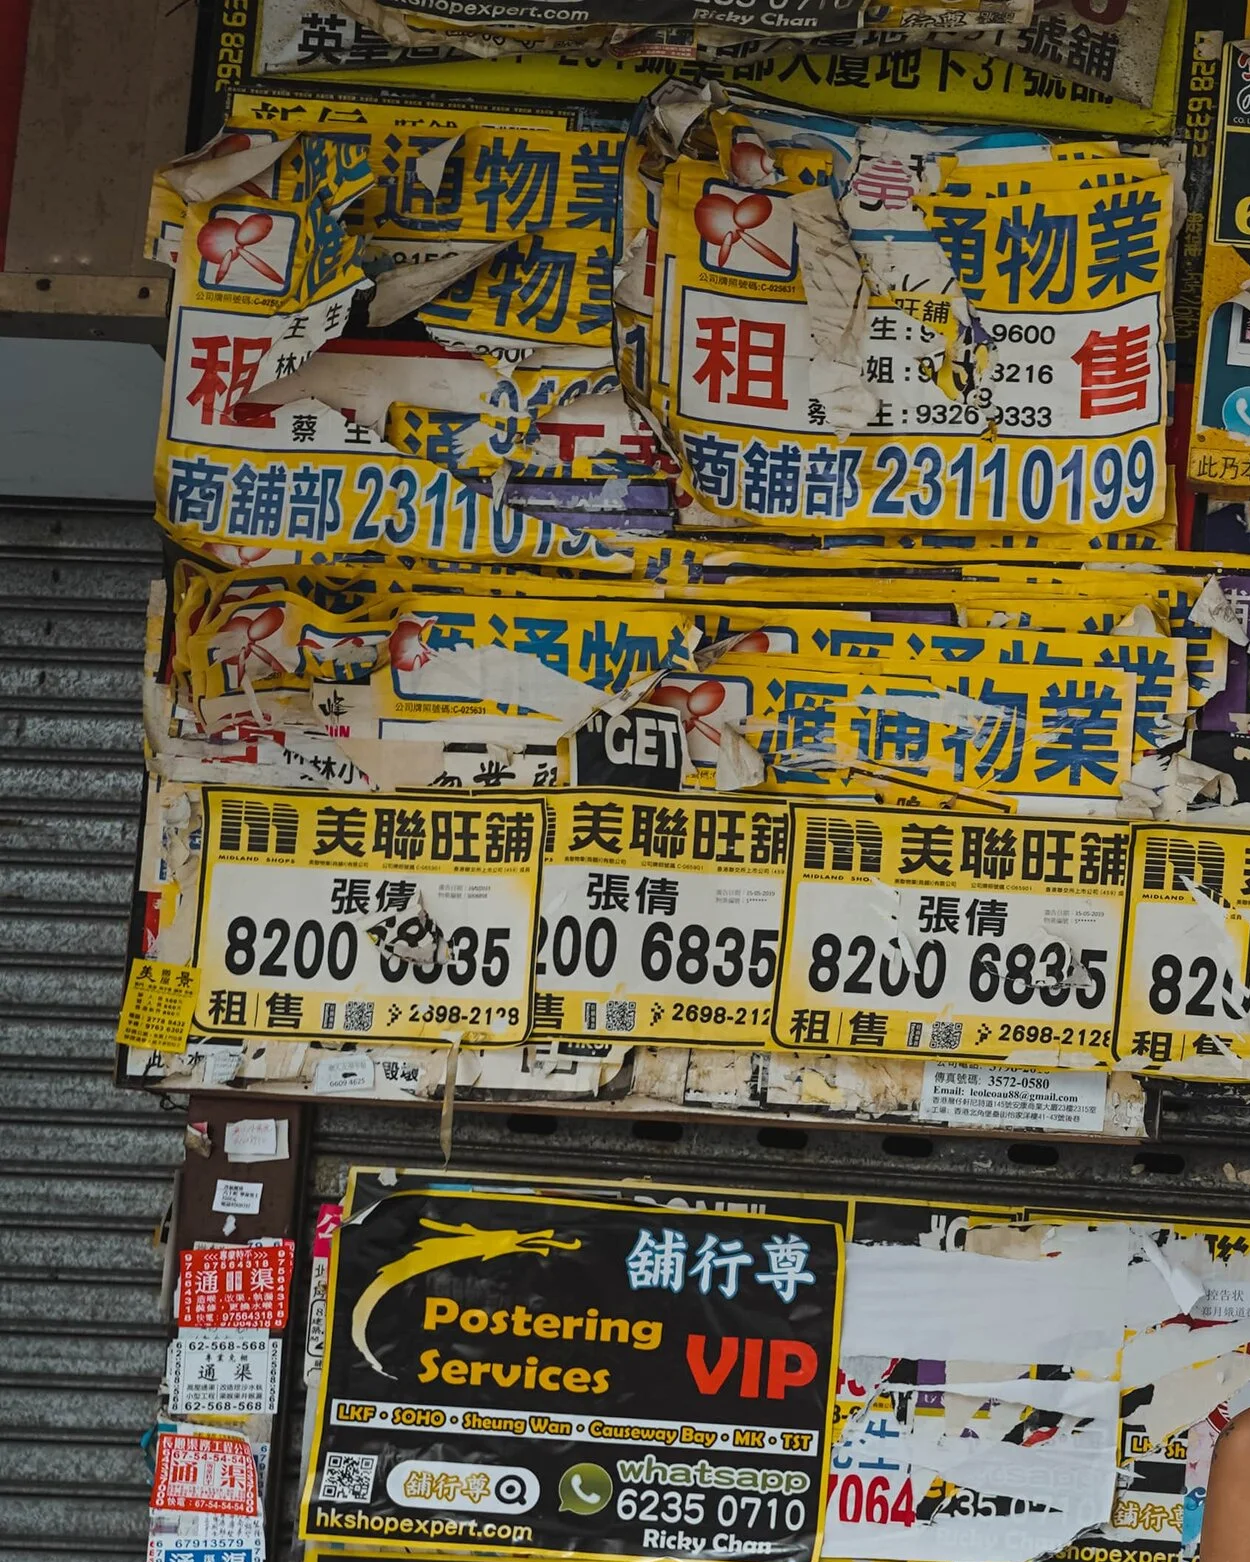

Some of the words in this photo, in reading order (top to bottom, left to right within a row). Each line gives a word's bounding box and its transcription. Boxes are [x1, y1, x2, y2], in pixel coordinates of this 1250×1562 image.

[692, 8, 753, 24] Ricky
[760, 12, 818, 27] Chan
[693, 315, 788, 411] 租
[1070, 326, 1151, 421] 售
[916, 403, 979, 426] 9326
[167, 457, 345, 541] 商舖部
[683, 431, 863, 519] 商舖部
[872, 439, 1156, 525] 23110199
[313, 805, 535, 864] 美聯旺舖
[568, 800, 788, 868] 美聯旺舖
[898, 822, 1129, 889] 美聯旺舖
[218, 855, 260, 863] MIDLAND
[802, 872, 848, 883] MIDLAND
[330, 877, 418, 916] 張倩
[586, 872, 679, 917] 張倩
[1141, 893, 1185, 903] MIDLAND
[918, 894, 1010, 939] 張倩
[225, 915, 358, 980] 8200
[640, 921, 779, 988] 6835
[808, 930, 947, 1000] 8200
[968, 938, 1108, 1009] 6835
[208, 989, 247, 1027] 租
[265, 991, 304, 1031] 售
[789, 1008, 831, 1047] 租
[847, 1010, 889, 1048] 售
[1131, 1028, 1173, 1065] 租
[933, 1086, 965, 1097] Email:
[988, 1076, 1050, 1090] 3572-0580
[625, 1227, 817, 1304] 舖行尊
[422, 1296, 664, 1351] Postering
[188, 1341, 266, 1351] 62-568-568
[684, 1333, 819, 1400] VIP
[417, 1348, 611, 1395] Services
[184, 1401, 262, 1411] 62-568-568
[336, 1403, 375, 1424] LKF
[392, 1407, 445, 1428] SOHO
[462, 1412, 526, 1437] Sheung
[529, 1417, 572, 1437] Wan
[589, 1421, 678, 1447] Causeway
[681, 1425, 717, 1448] Bay
[733, 1430, 765, 1449] MK
[782, 1433, 812, 1452] TST
[173, 1451, 245, 1465] 67-54-54-54
[616, 1454, 811, 1495] whatsapp
[315, 1506, 534, 1541] hkshopexpert.com
[617, 1488, 706, 1525] 6235
[717, 1495, 807, 1532] 0710
[175, 1539, 244, 1549] 67913579
[642, 1529, 707, 1556] Ricky
[712, 1532, 773, 1556] Chan
